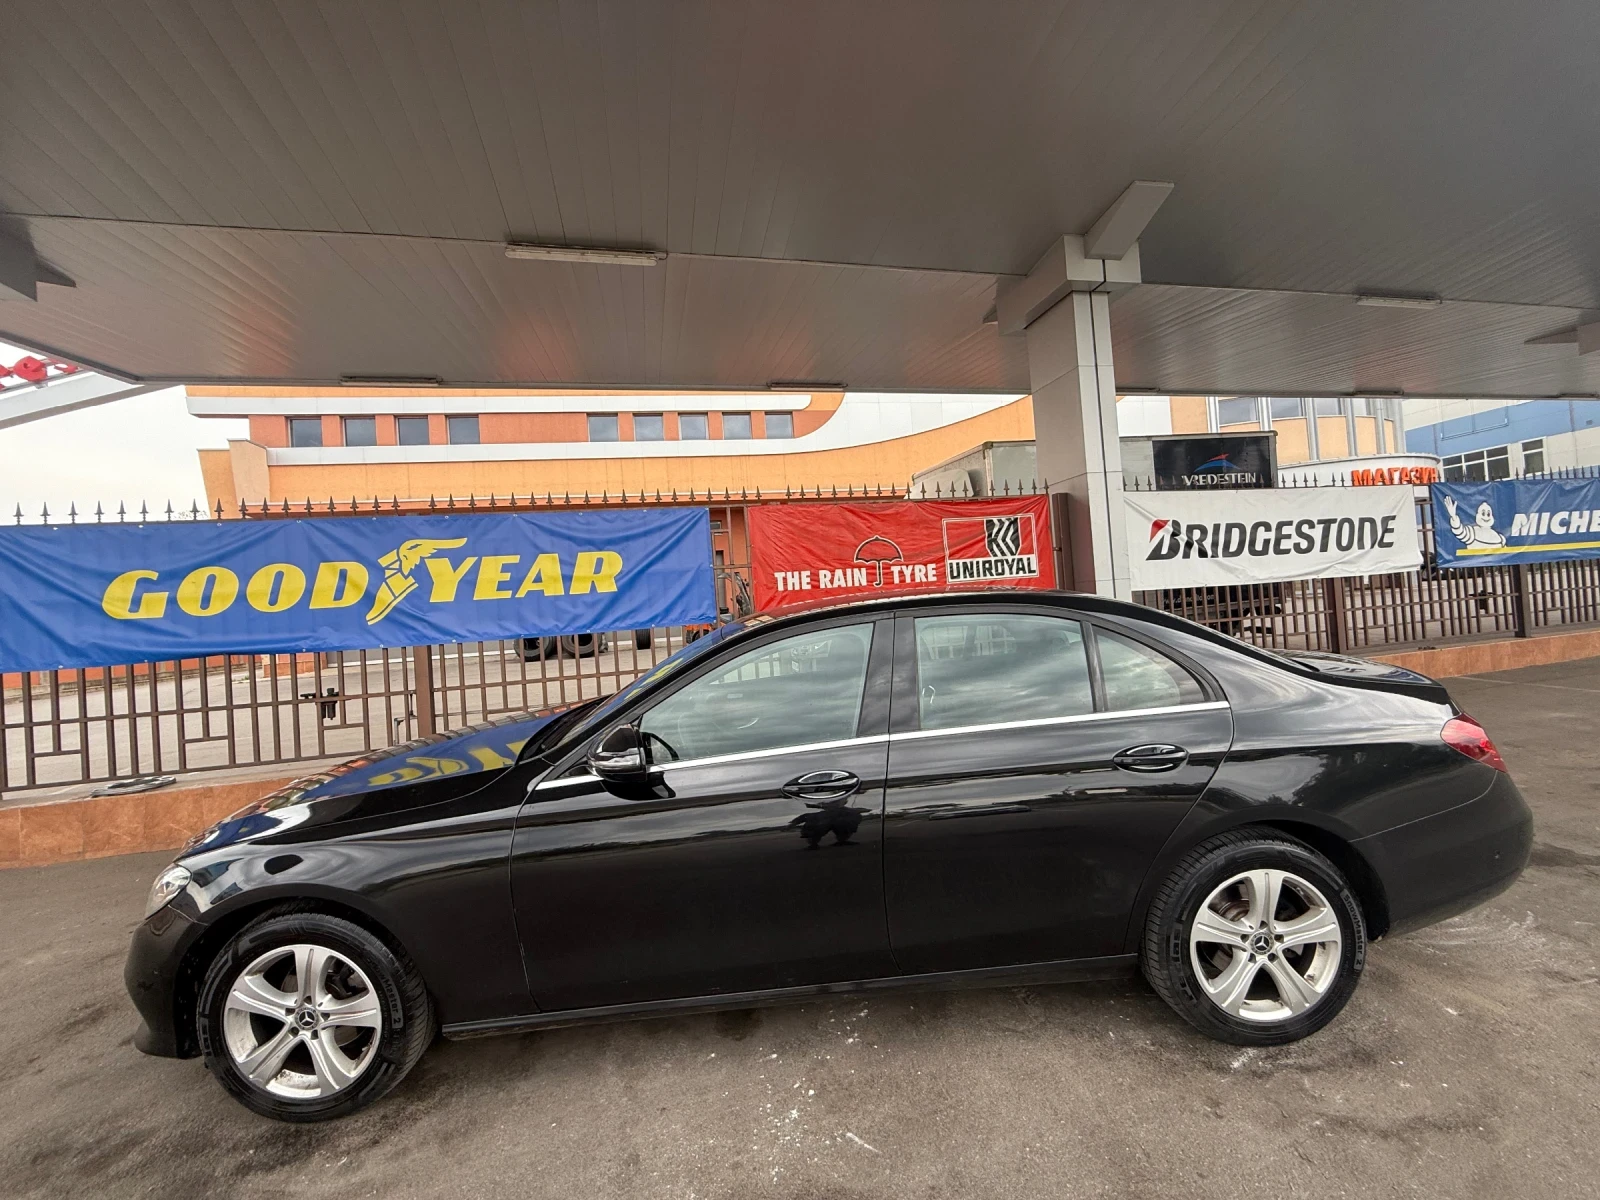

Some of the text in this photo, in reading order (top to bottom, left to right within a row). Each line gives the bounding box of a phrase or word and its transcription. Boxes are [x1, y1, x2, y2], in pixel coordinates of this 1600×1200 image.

[1181, 472, 1257, 487] VREDESTEIN
[1146, 514, 1397, 562] BRIDGESTONE
[774, 563, 938, 592] THE RAIN TYRE
[949, 556, 1037, 580] UNIROYAL
